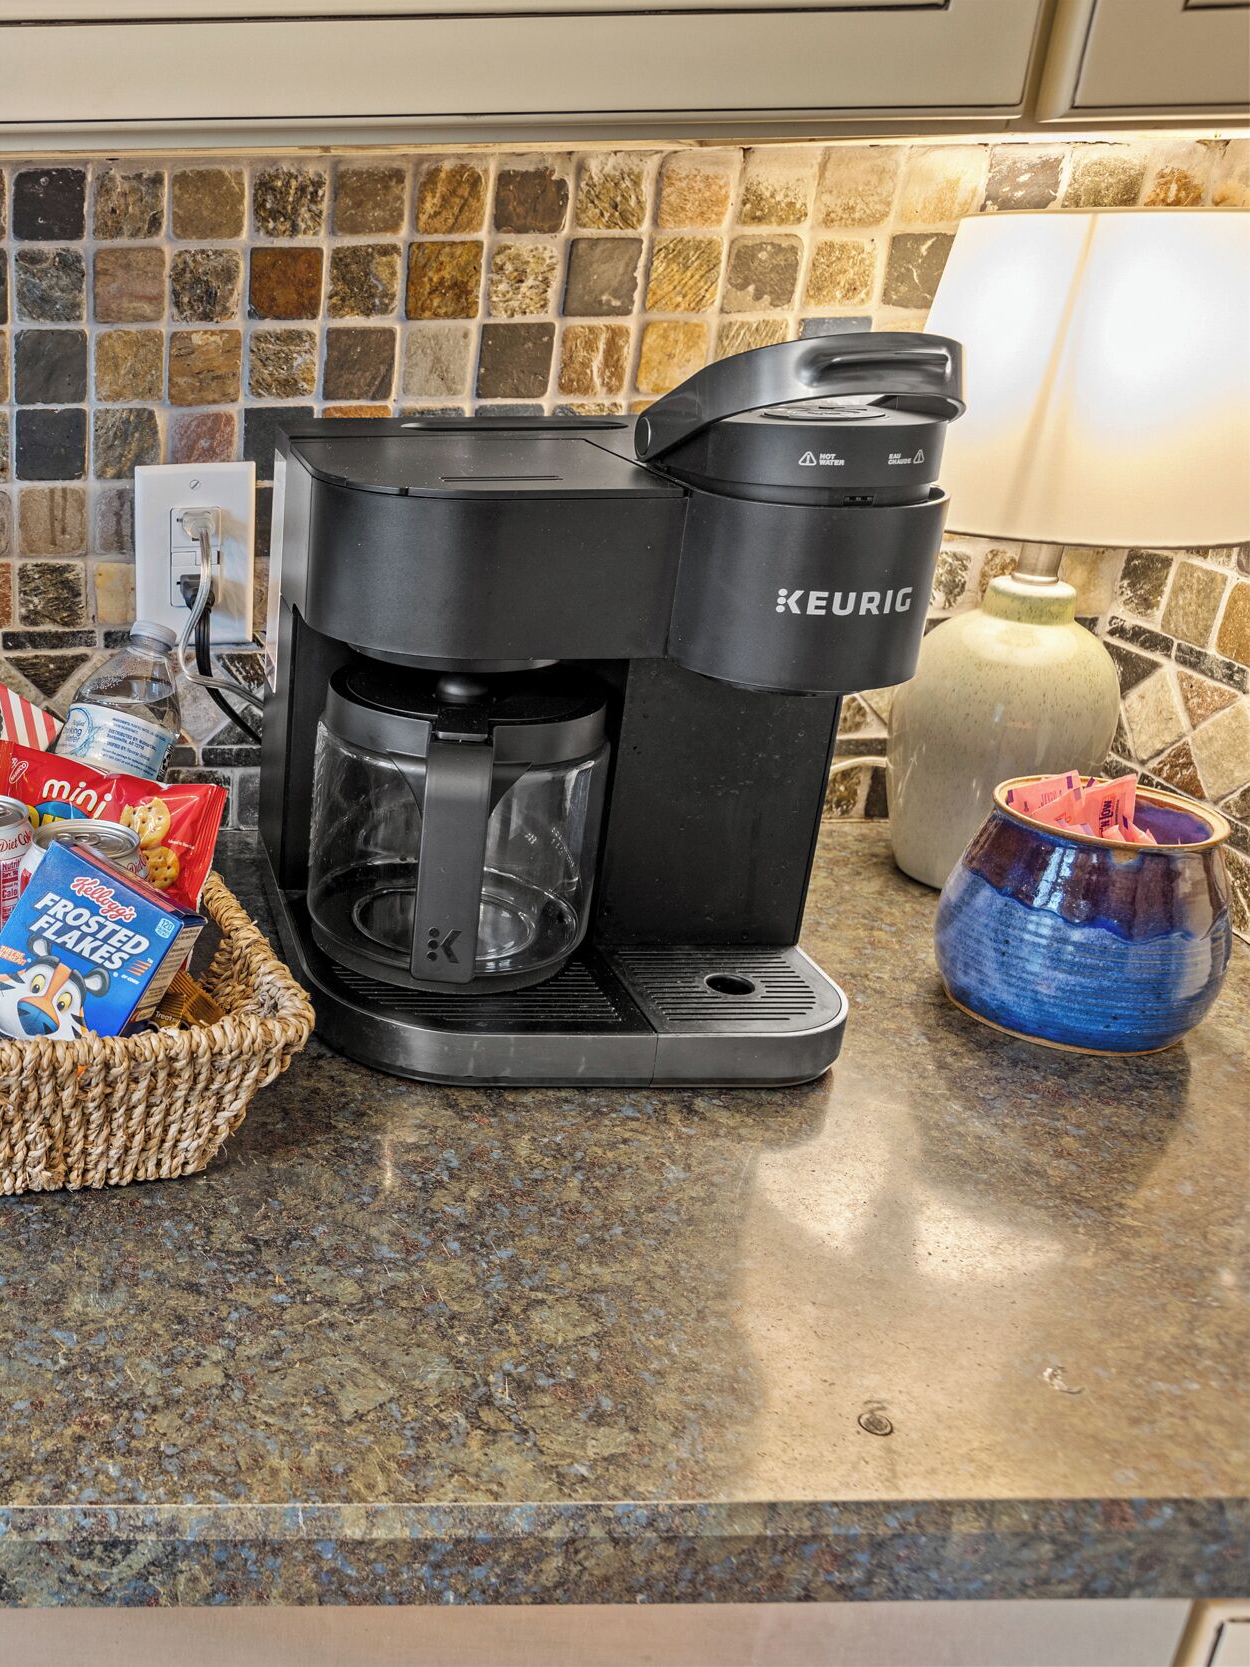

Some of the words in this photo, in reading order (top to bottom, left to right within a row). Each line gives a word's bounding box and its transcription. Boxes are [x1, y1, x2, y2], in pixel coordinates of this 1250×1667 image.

[775, 587, 913, 616] KEURIG
[42, 779, 113, 819] mini
[71, 877, 138, 921] Kellogg's
[29, 914, 131, 970] FLAKES
[34, 892, 150, 956] FROSTED
[160, 919, 174, 931] 120
